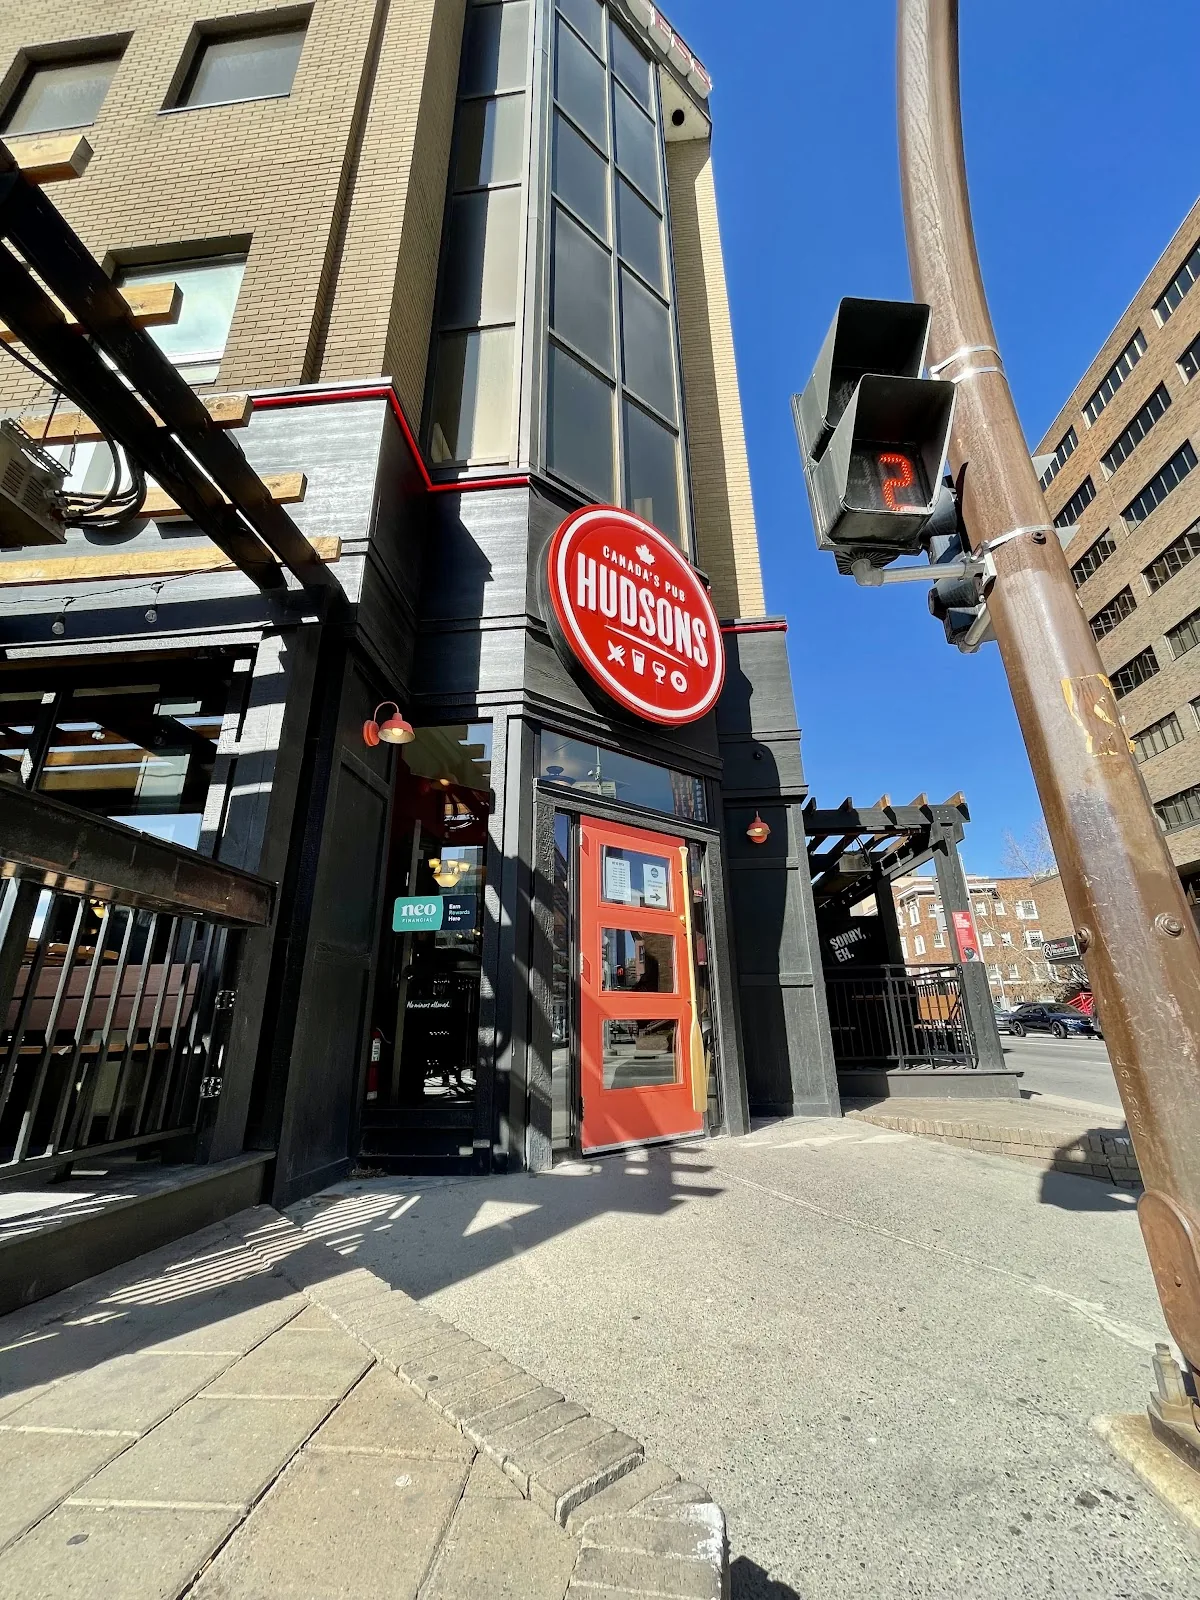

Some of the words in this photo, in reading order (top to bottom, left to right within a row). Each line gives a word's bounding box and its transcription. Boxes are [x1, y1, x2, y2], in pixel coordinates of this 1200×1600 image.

[879, 453, 914, 512] 2
[602, 545, 660, 588] CANADA'S
[665, 581, 685, 602] PUB
[577, 551, 709, 668] HUDSONS
[401, 903, 436, 916] neo
